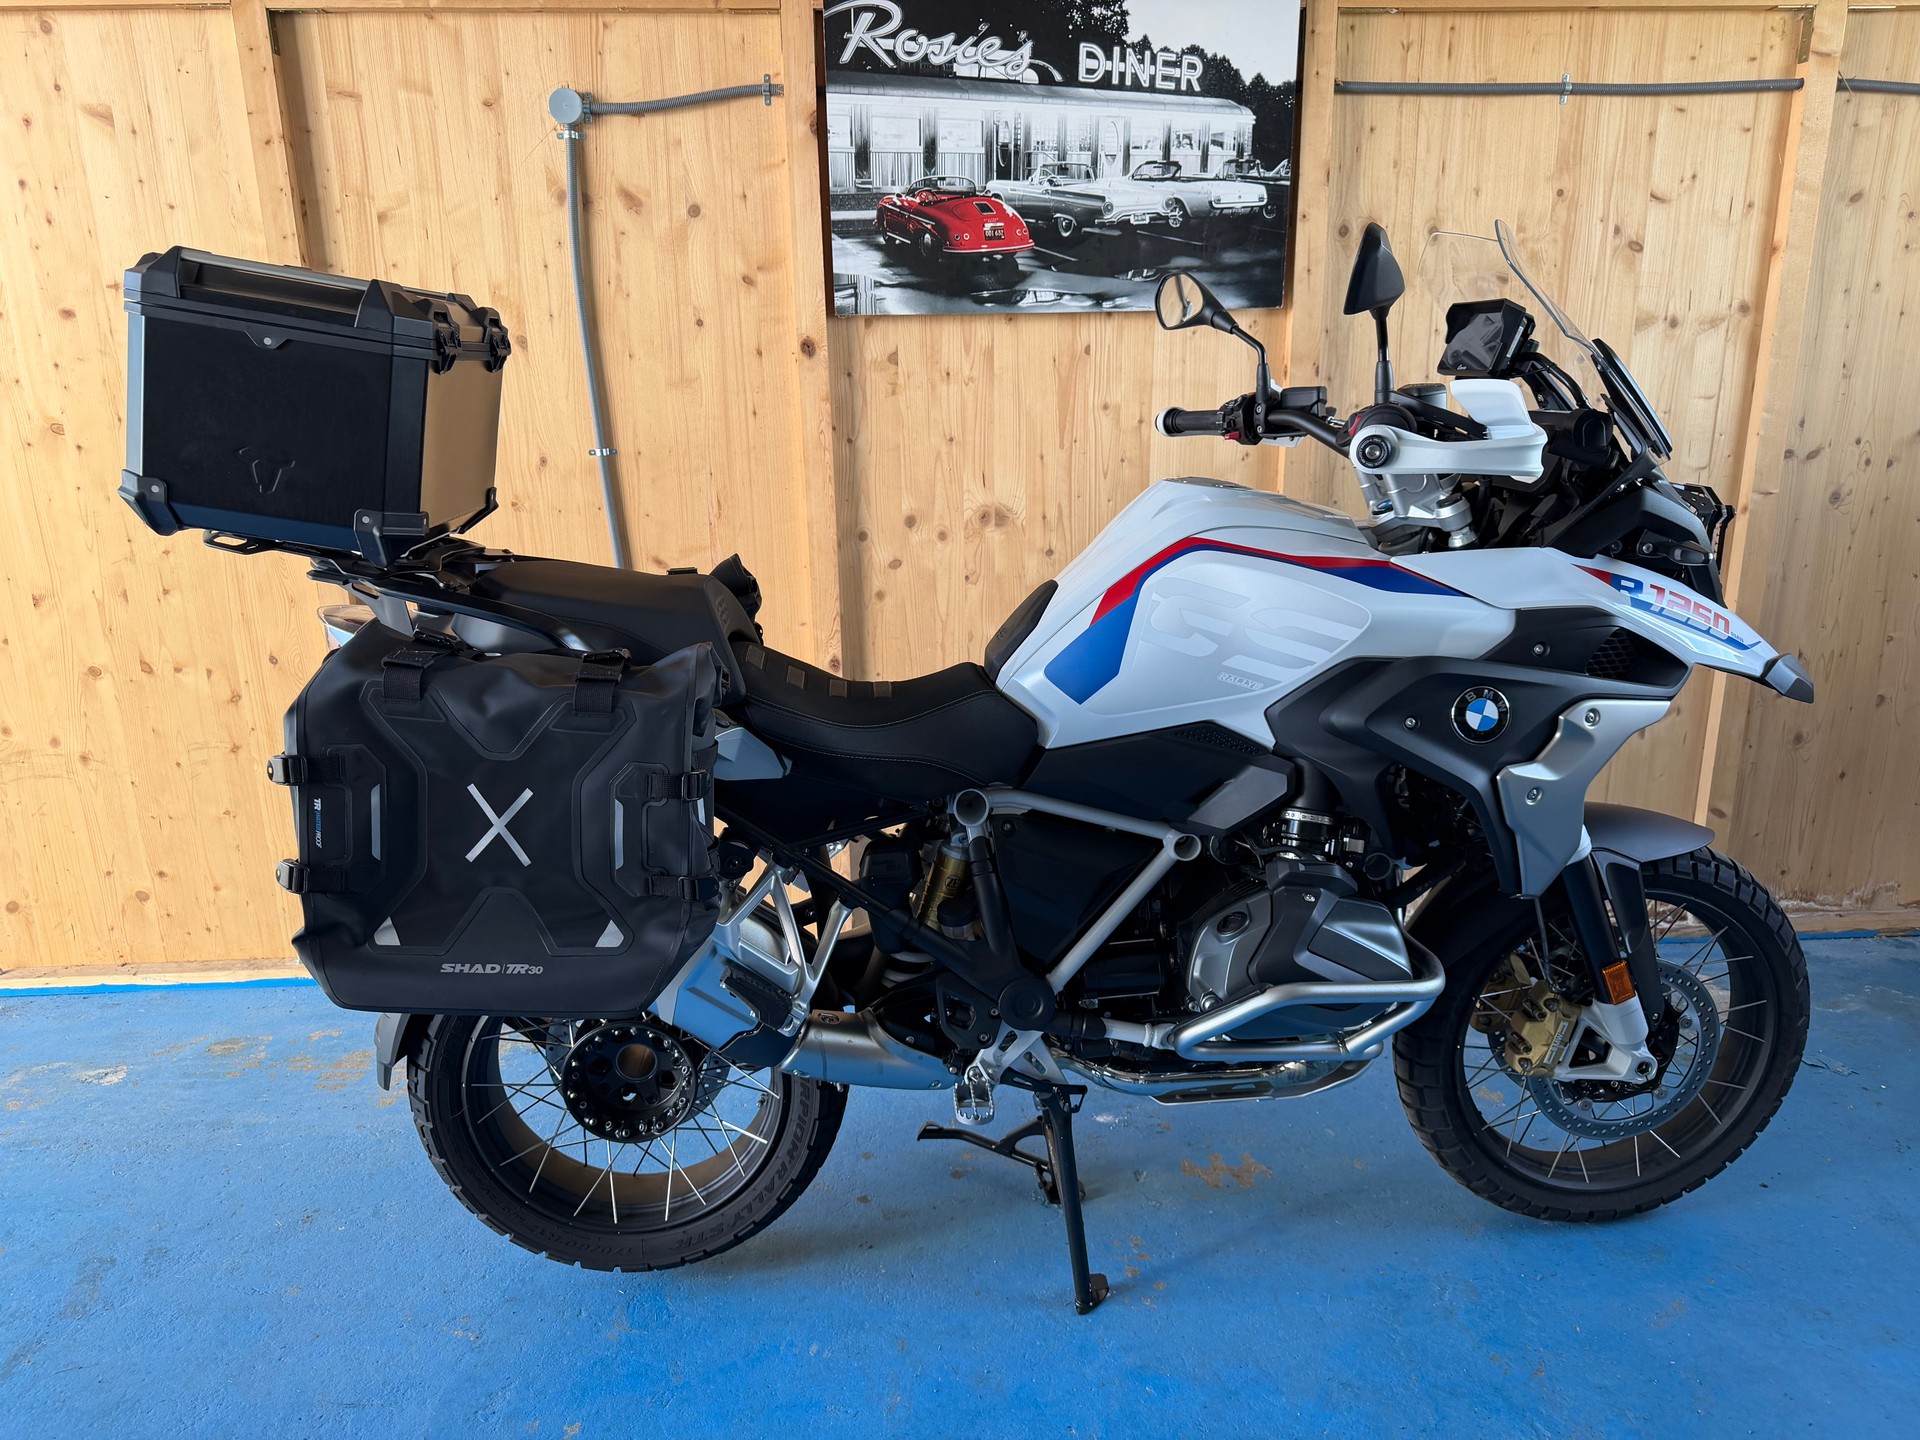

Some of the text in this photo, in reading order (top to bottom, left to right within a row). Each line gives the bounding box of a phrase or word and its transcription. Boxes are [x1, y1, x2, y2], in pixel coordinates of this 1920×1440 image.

[1078, 42, 1203, 92] DINER
[1650, 584, 1730, 638] 1250
[1464, 689, 1507, 712] BMW
[440, 963, 501, 974] SHAD
